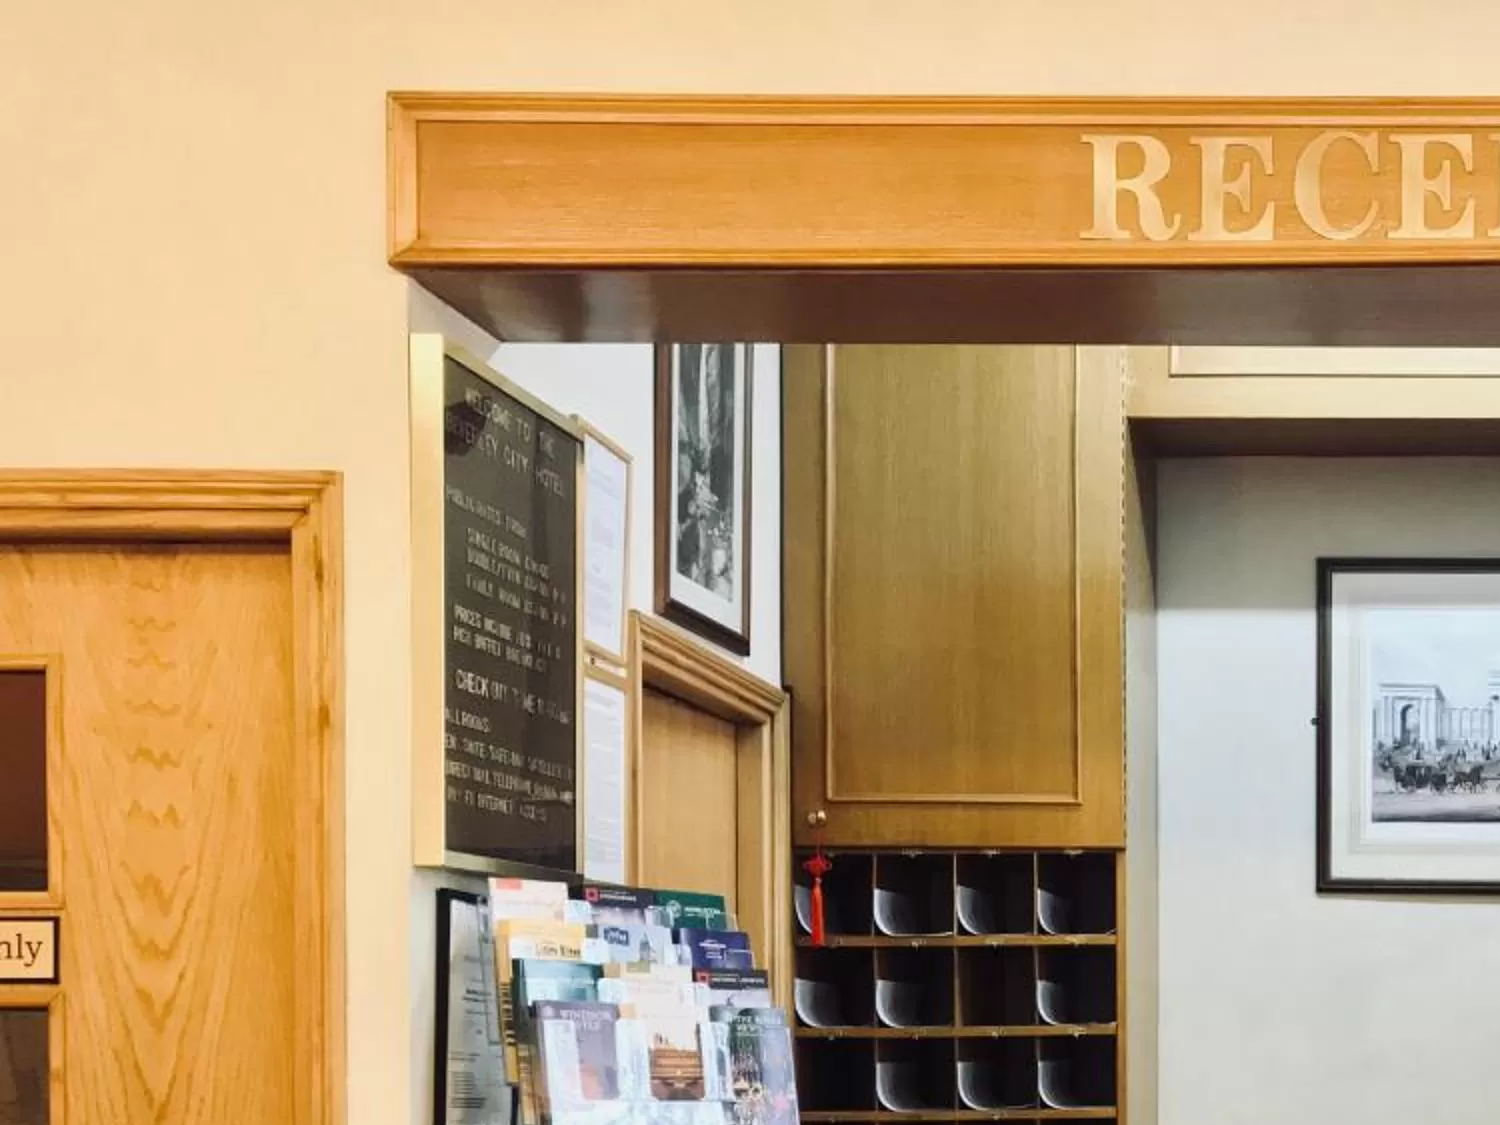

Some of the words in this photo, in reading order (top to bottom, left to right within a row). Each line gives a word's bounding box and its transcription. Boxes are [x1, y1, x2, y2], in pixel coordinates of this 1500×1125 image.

[516, 417, 531, 443] TO
[503, 442, 529, 472] CITY
[535, 465, 565, 498] HOTEL
[455, 668, 489, 699] CHECK
[490, 679, 508, 704] OUT
[0, 933, 43, 968] nly
